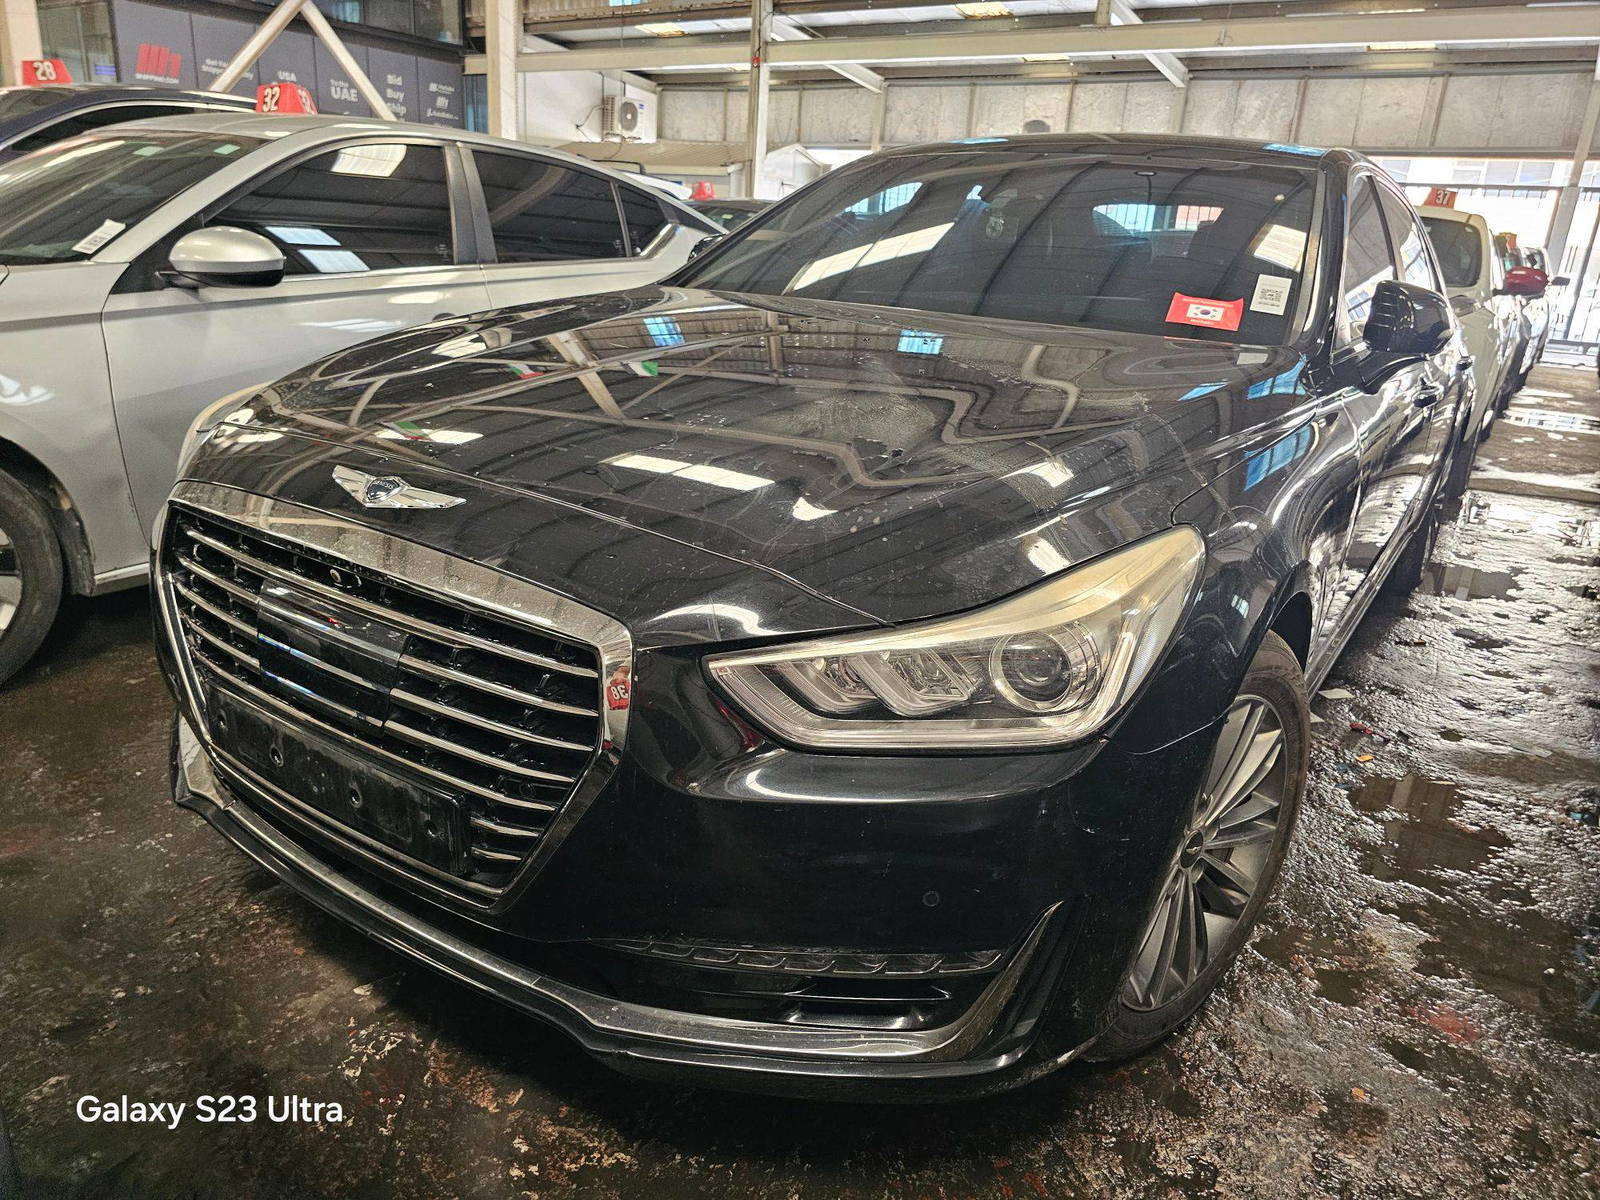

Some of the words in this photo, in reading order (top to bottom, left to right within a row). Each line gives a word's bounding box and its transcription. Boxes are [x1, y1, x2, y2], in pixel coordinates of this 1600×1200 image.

[32, 60, 57, 81] 28
[278, 71, 297, 81] USA
[386, 73, 403, 86] Bid
[262, 86, 281, 112] 32
[331, 86, 359, 102] UAE
[386, 88, 405, 102] Buy
[1435, 188, 1452, 205] 37
